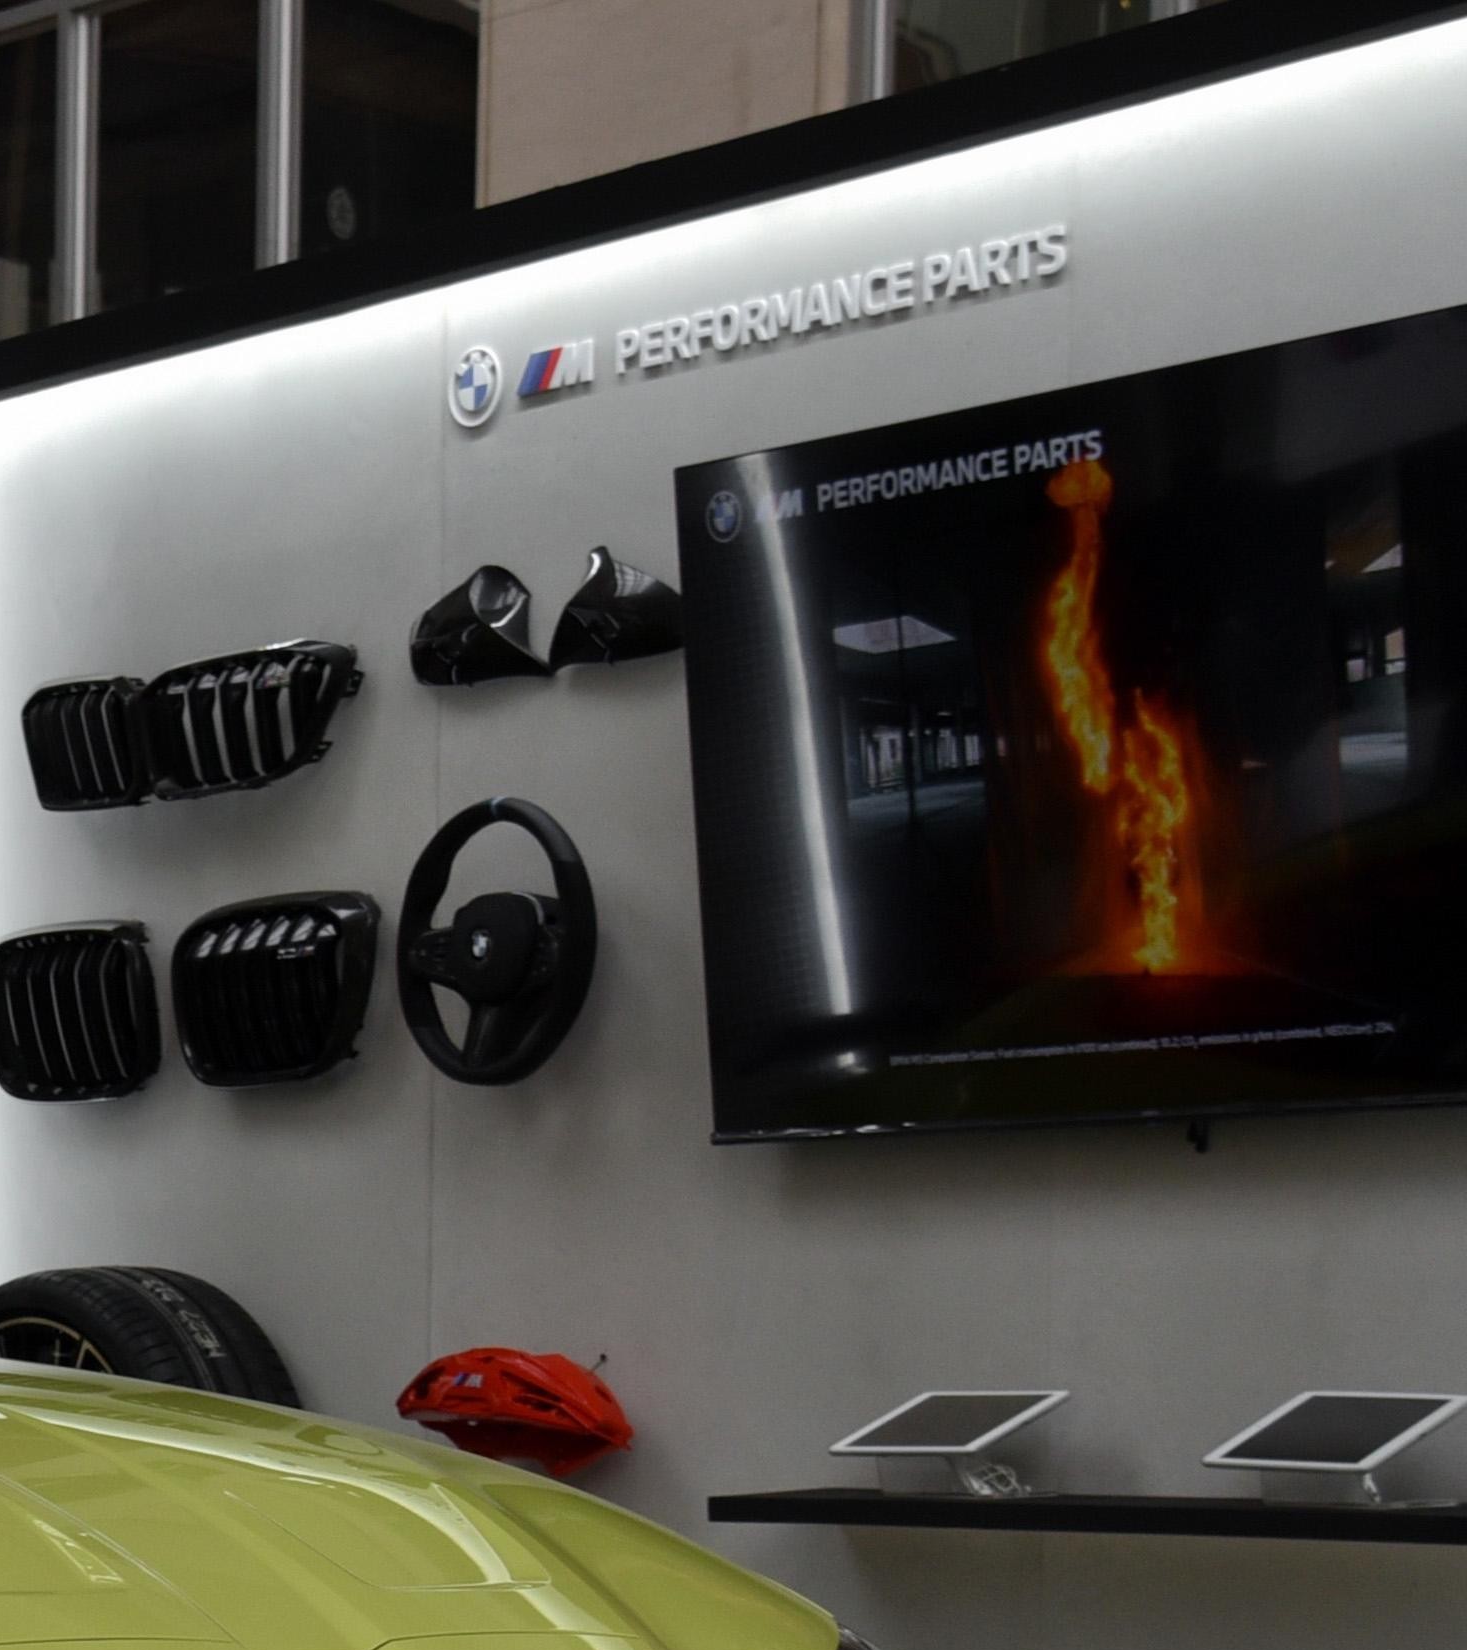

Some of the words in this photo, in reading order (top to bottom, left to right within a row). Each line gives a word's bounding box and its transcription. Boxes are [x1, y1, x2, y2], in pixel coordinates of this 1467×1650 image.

[615, 262, 914, 374] PERFORMANCE
[923, 225, 1066, 301] PARTS
[817, 449, 1009, 512] PERFORMANCE
[1014, 430, 1102, 474] PARTS
